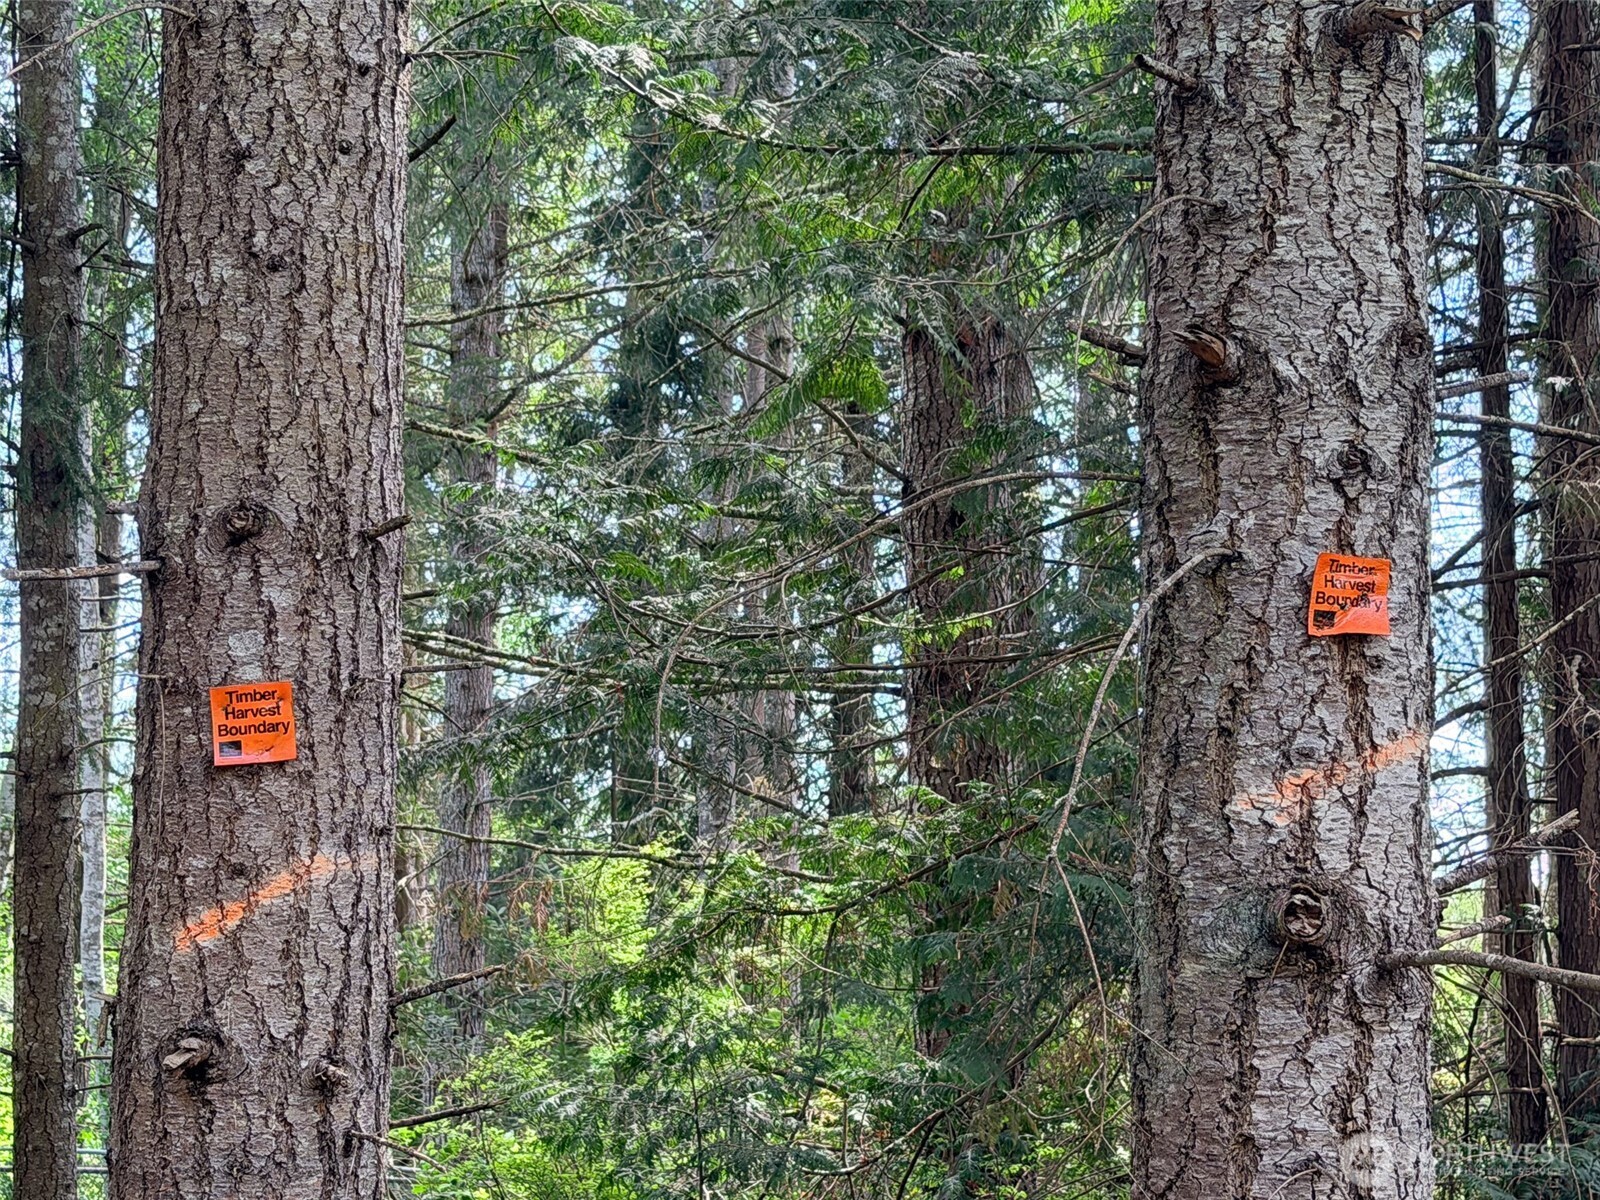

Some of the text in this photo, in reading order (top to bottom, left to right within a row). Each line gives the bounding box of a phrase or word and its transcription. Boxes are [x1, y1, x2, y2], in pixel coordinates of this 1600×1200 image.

[1329, 558, 1376, 575] Timber
[1324, 574, 1377, 593] Harvest
[1315, 591, 1383, 612] Boundary
[225, 689, 277, 704] Timber
[224, 701, 282, 720] Harvest
[218, 720, 290, 737] Boundary
